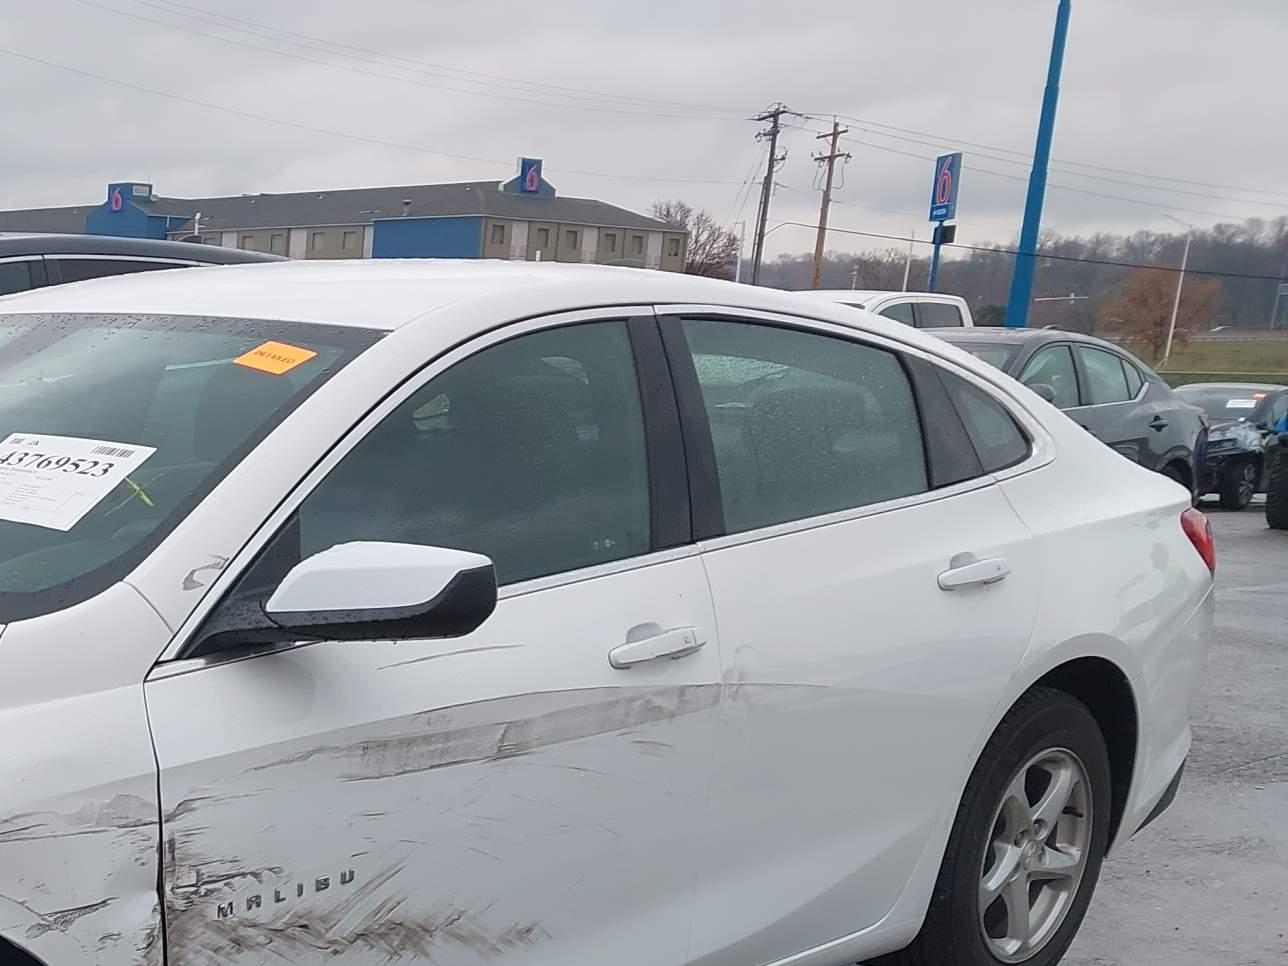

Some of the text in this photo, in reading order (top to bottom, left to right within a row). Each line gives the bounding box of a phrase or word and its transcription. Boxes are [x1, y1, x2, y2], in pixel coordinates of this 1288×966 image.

[526, 164, 540, 192] 6
[937, 156, 953, 205] 6
[111, 187, 123, 212] 6
[217, 868, 356, 919] MALIBU
